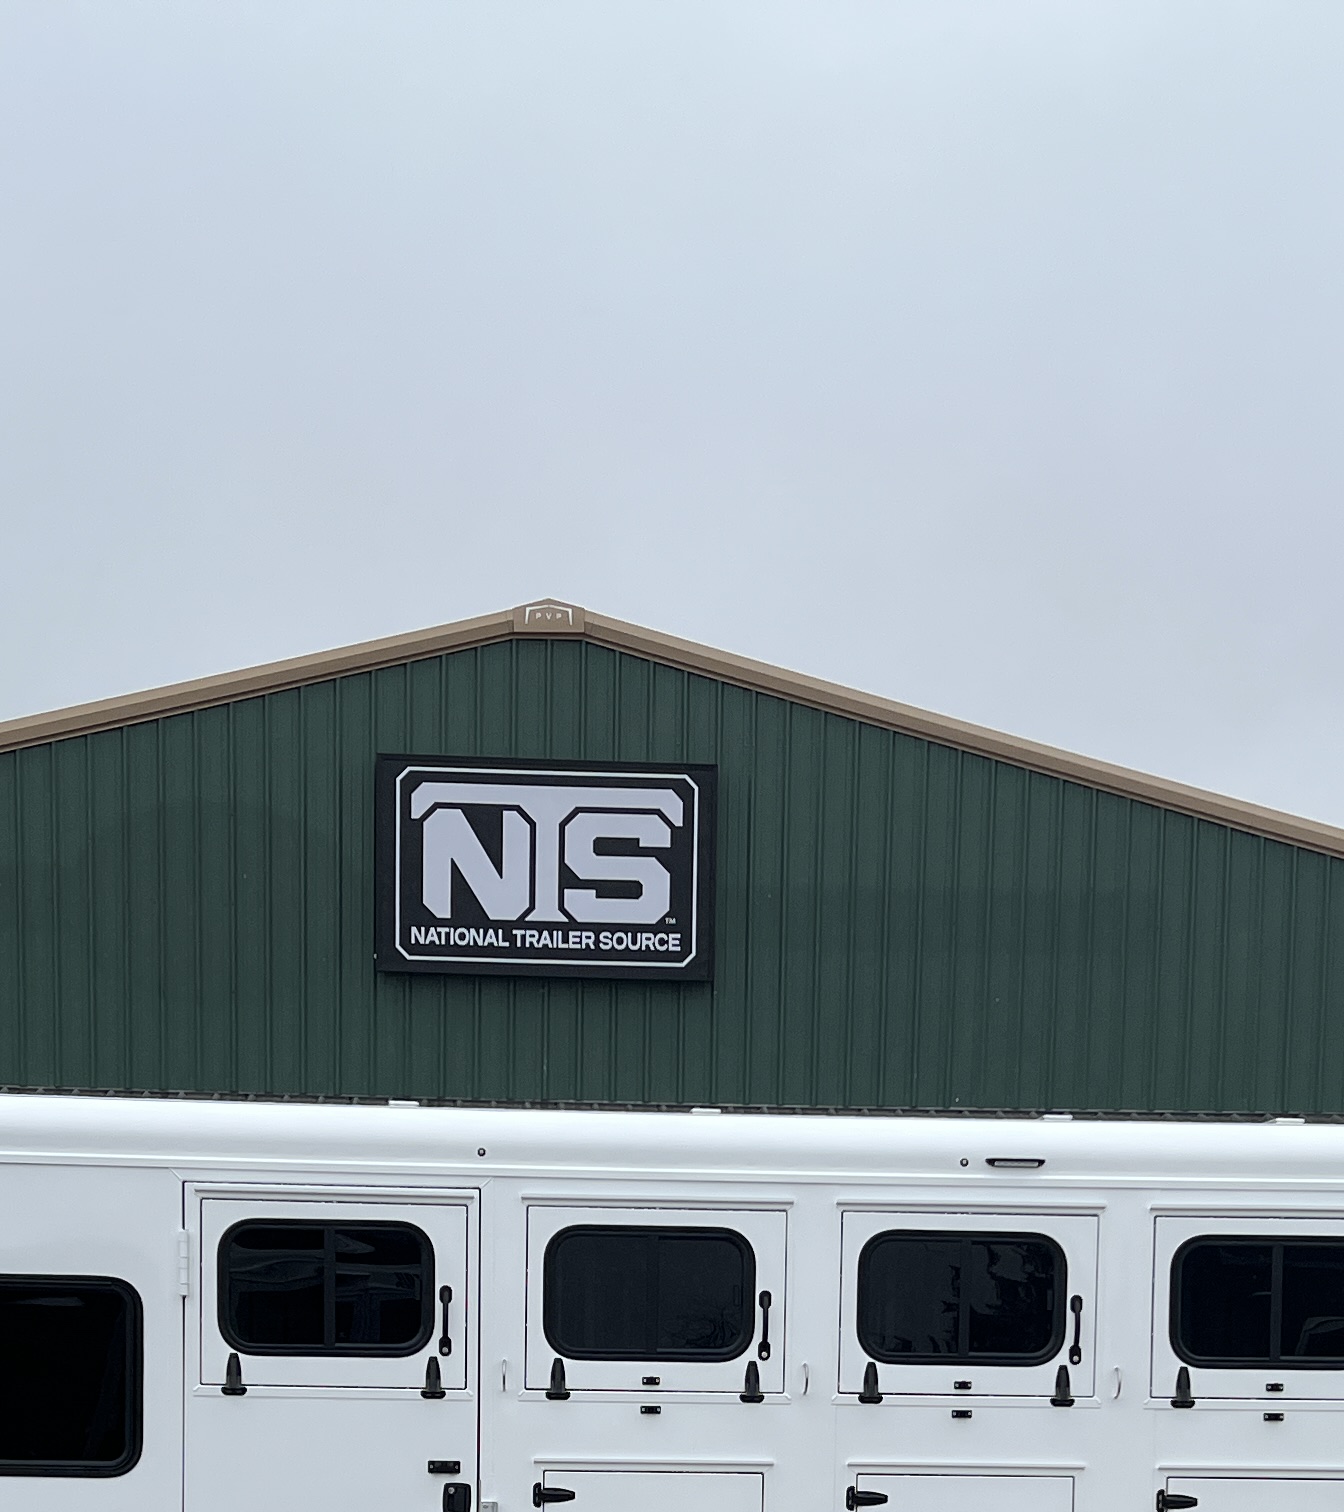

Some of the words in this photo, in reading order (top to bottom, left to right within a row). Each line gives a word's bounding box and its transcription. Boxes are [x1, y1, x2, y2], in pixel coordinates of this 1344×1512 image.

[411, 781, 684, 925] NTS
[410, 926, 509, 948] NATIONAL
[512, 929, 595, 950] TRAILER
[599, 931, 681, 952] SOURCE
